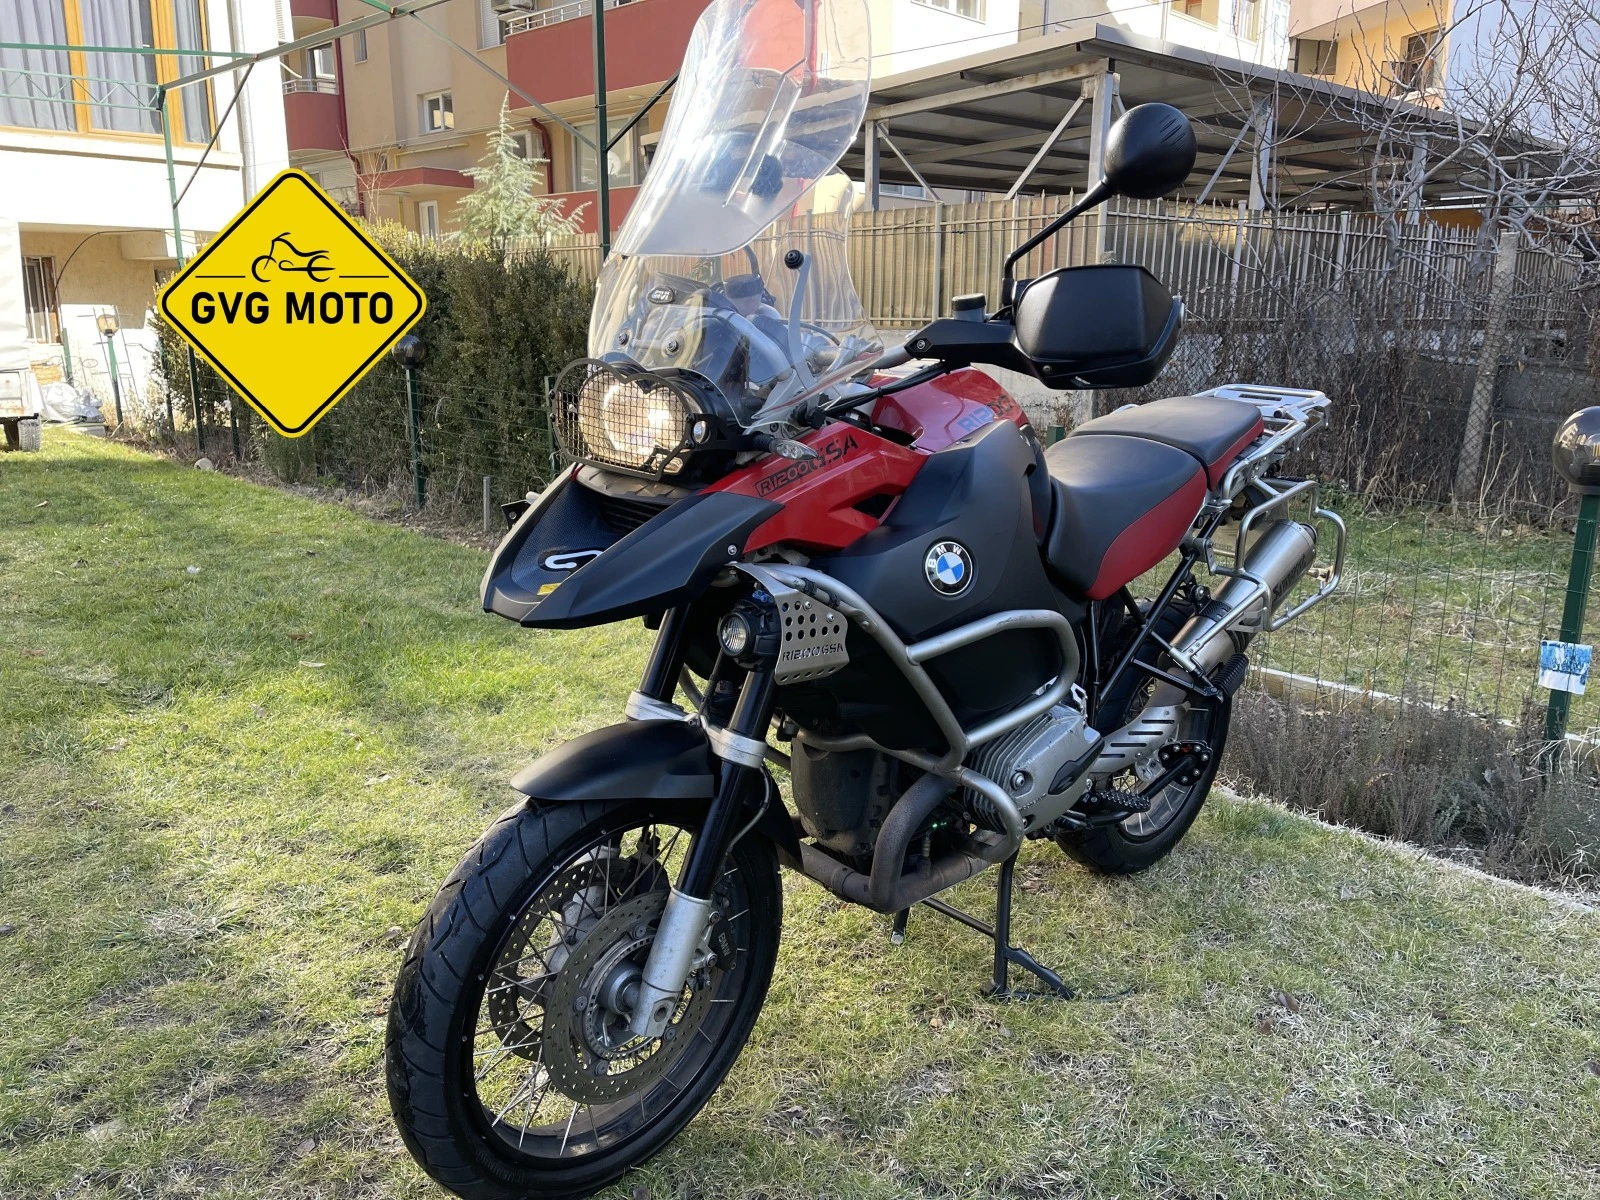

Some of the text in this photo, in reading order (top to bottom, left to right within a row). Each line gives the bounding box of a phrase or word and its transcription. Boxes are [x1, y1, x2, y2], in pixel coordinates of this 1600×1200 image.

[928, 544, 962, 569] BMW
[782, 643, 844, 662] R1200GSA
[718, 932, 731, 957] BMW
